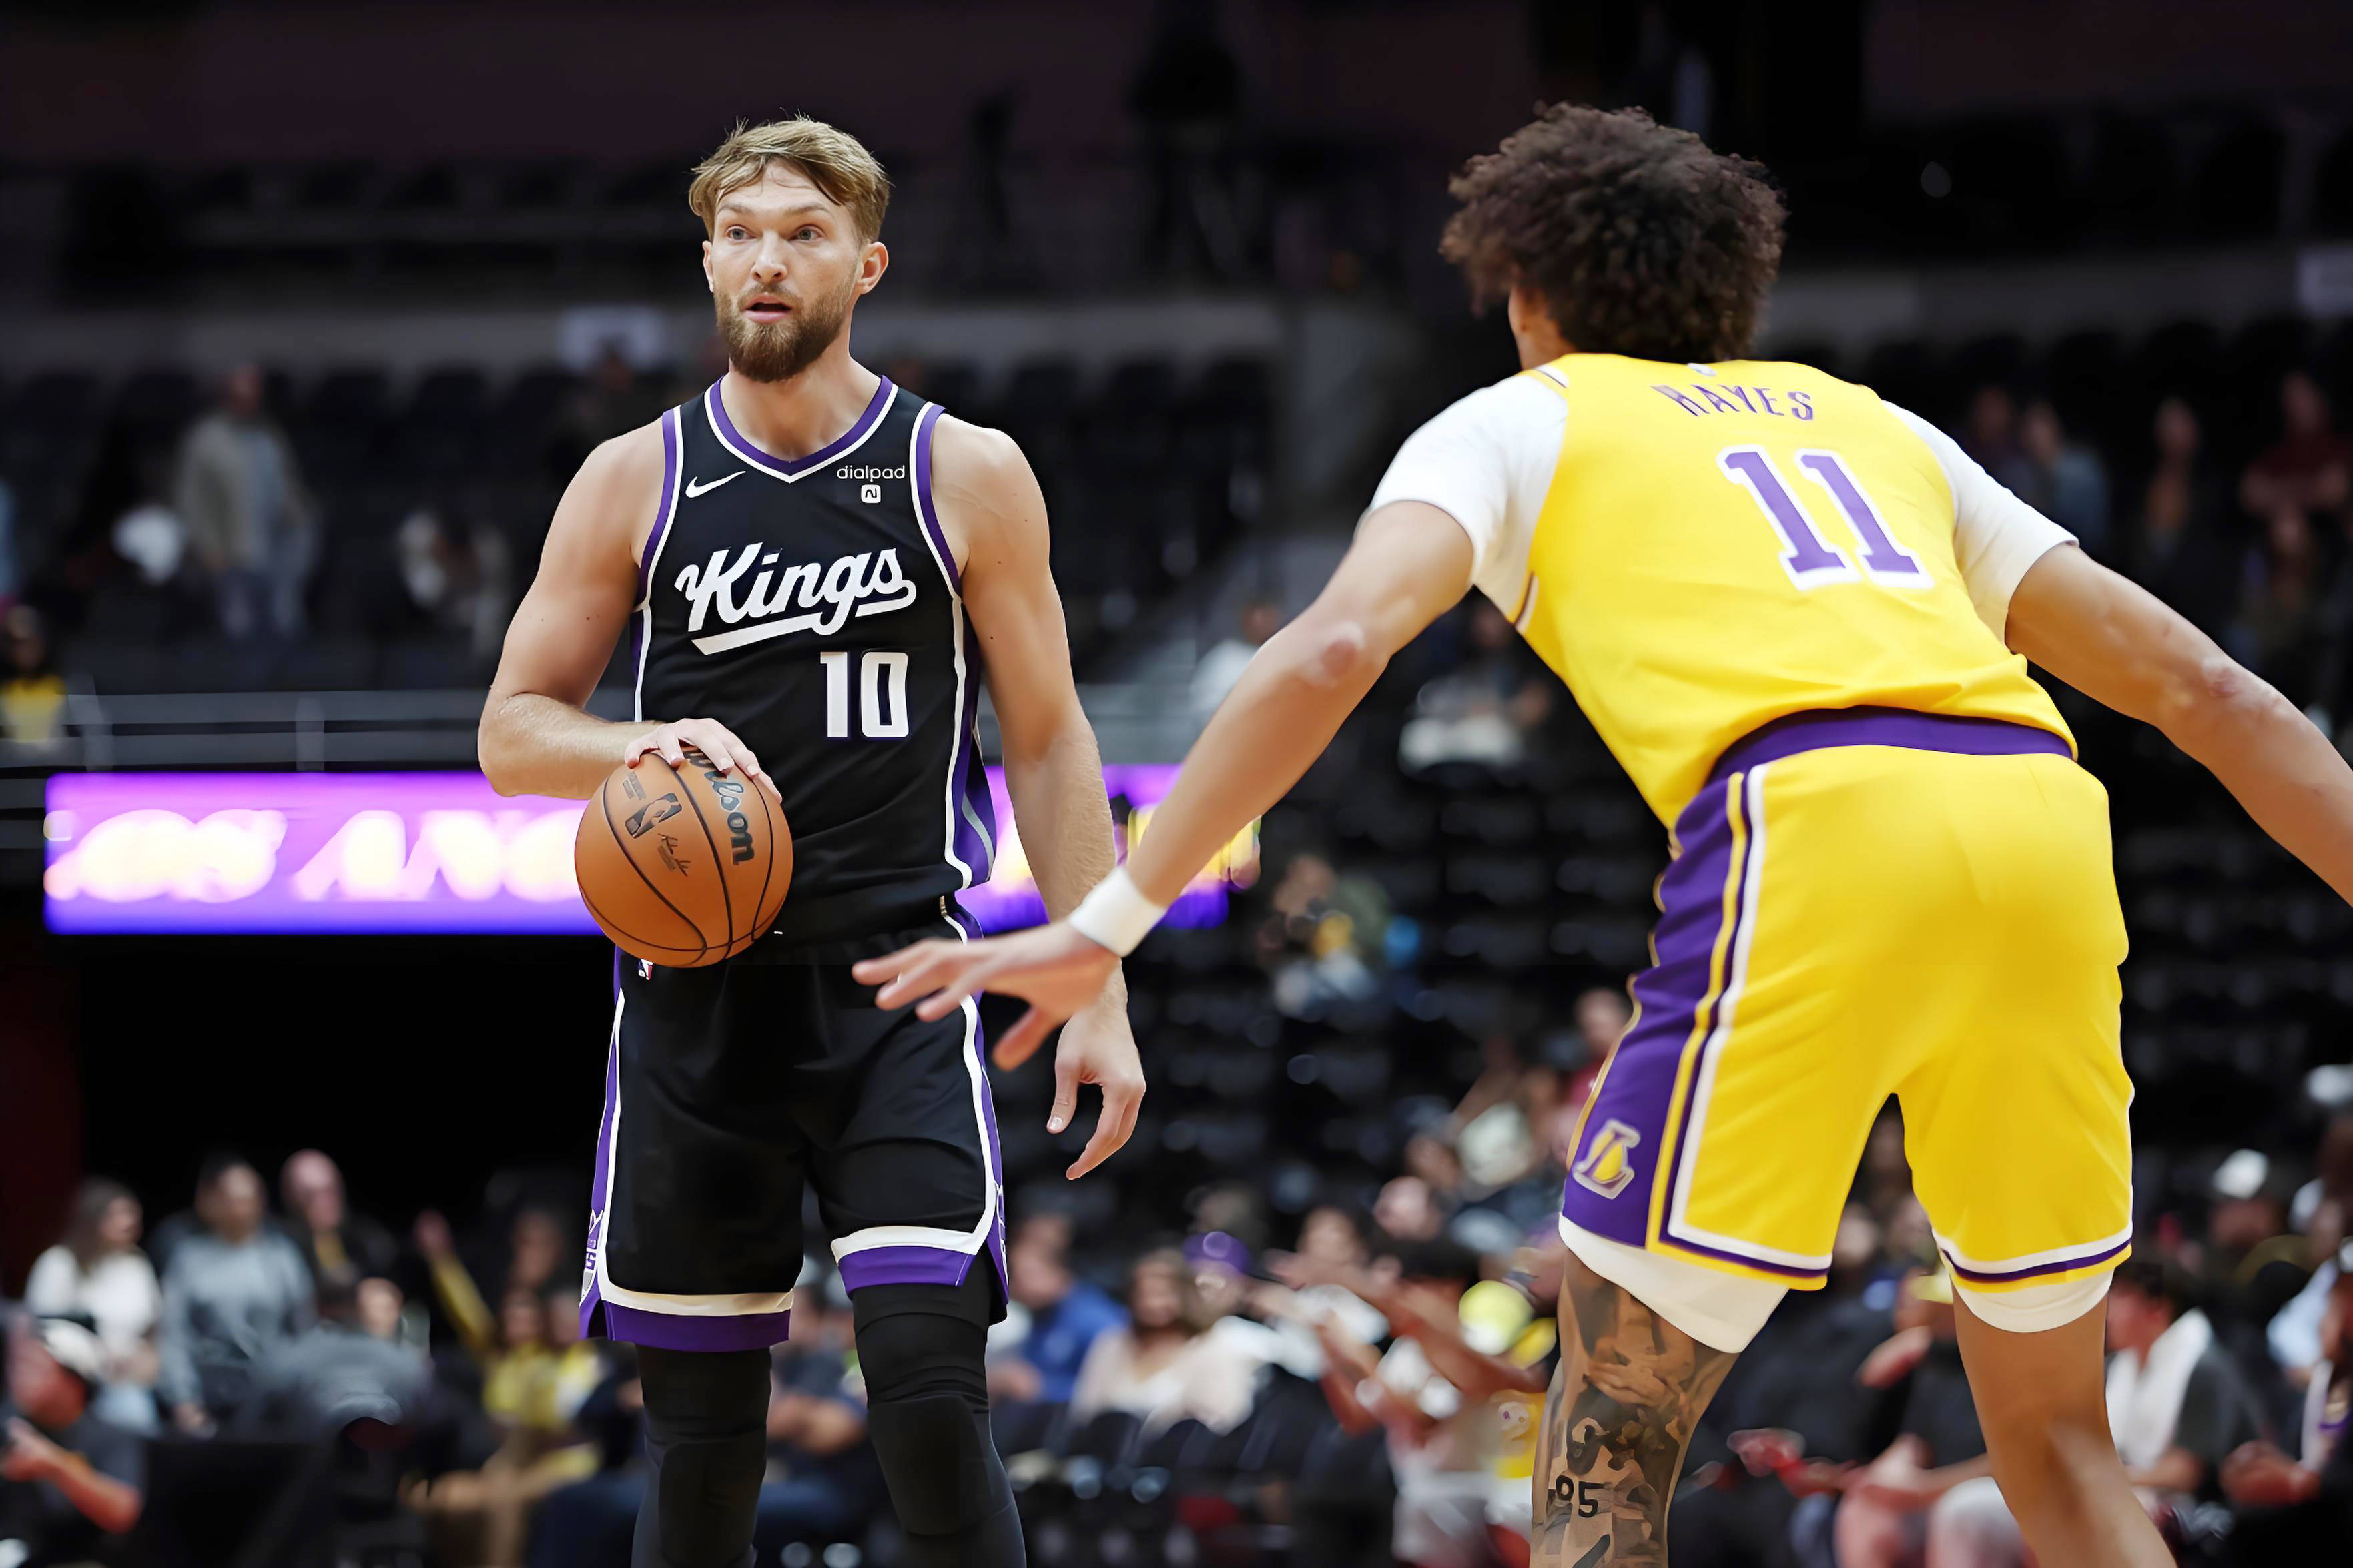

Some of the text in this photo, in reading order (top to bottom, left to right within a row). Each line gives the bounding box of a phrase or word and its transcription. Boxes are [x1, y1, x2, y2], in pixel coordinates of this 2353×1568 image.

[1650, 384, 1814, 421] HAYES
[837, 465, 905, 482] dialpad
[1716, 444, 1934, 591] 11
[675, 542, 917, 655] Kings
[820, 651, 910, 738] 10
